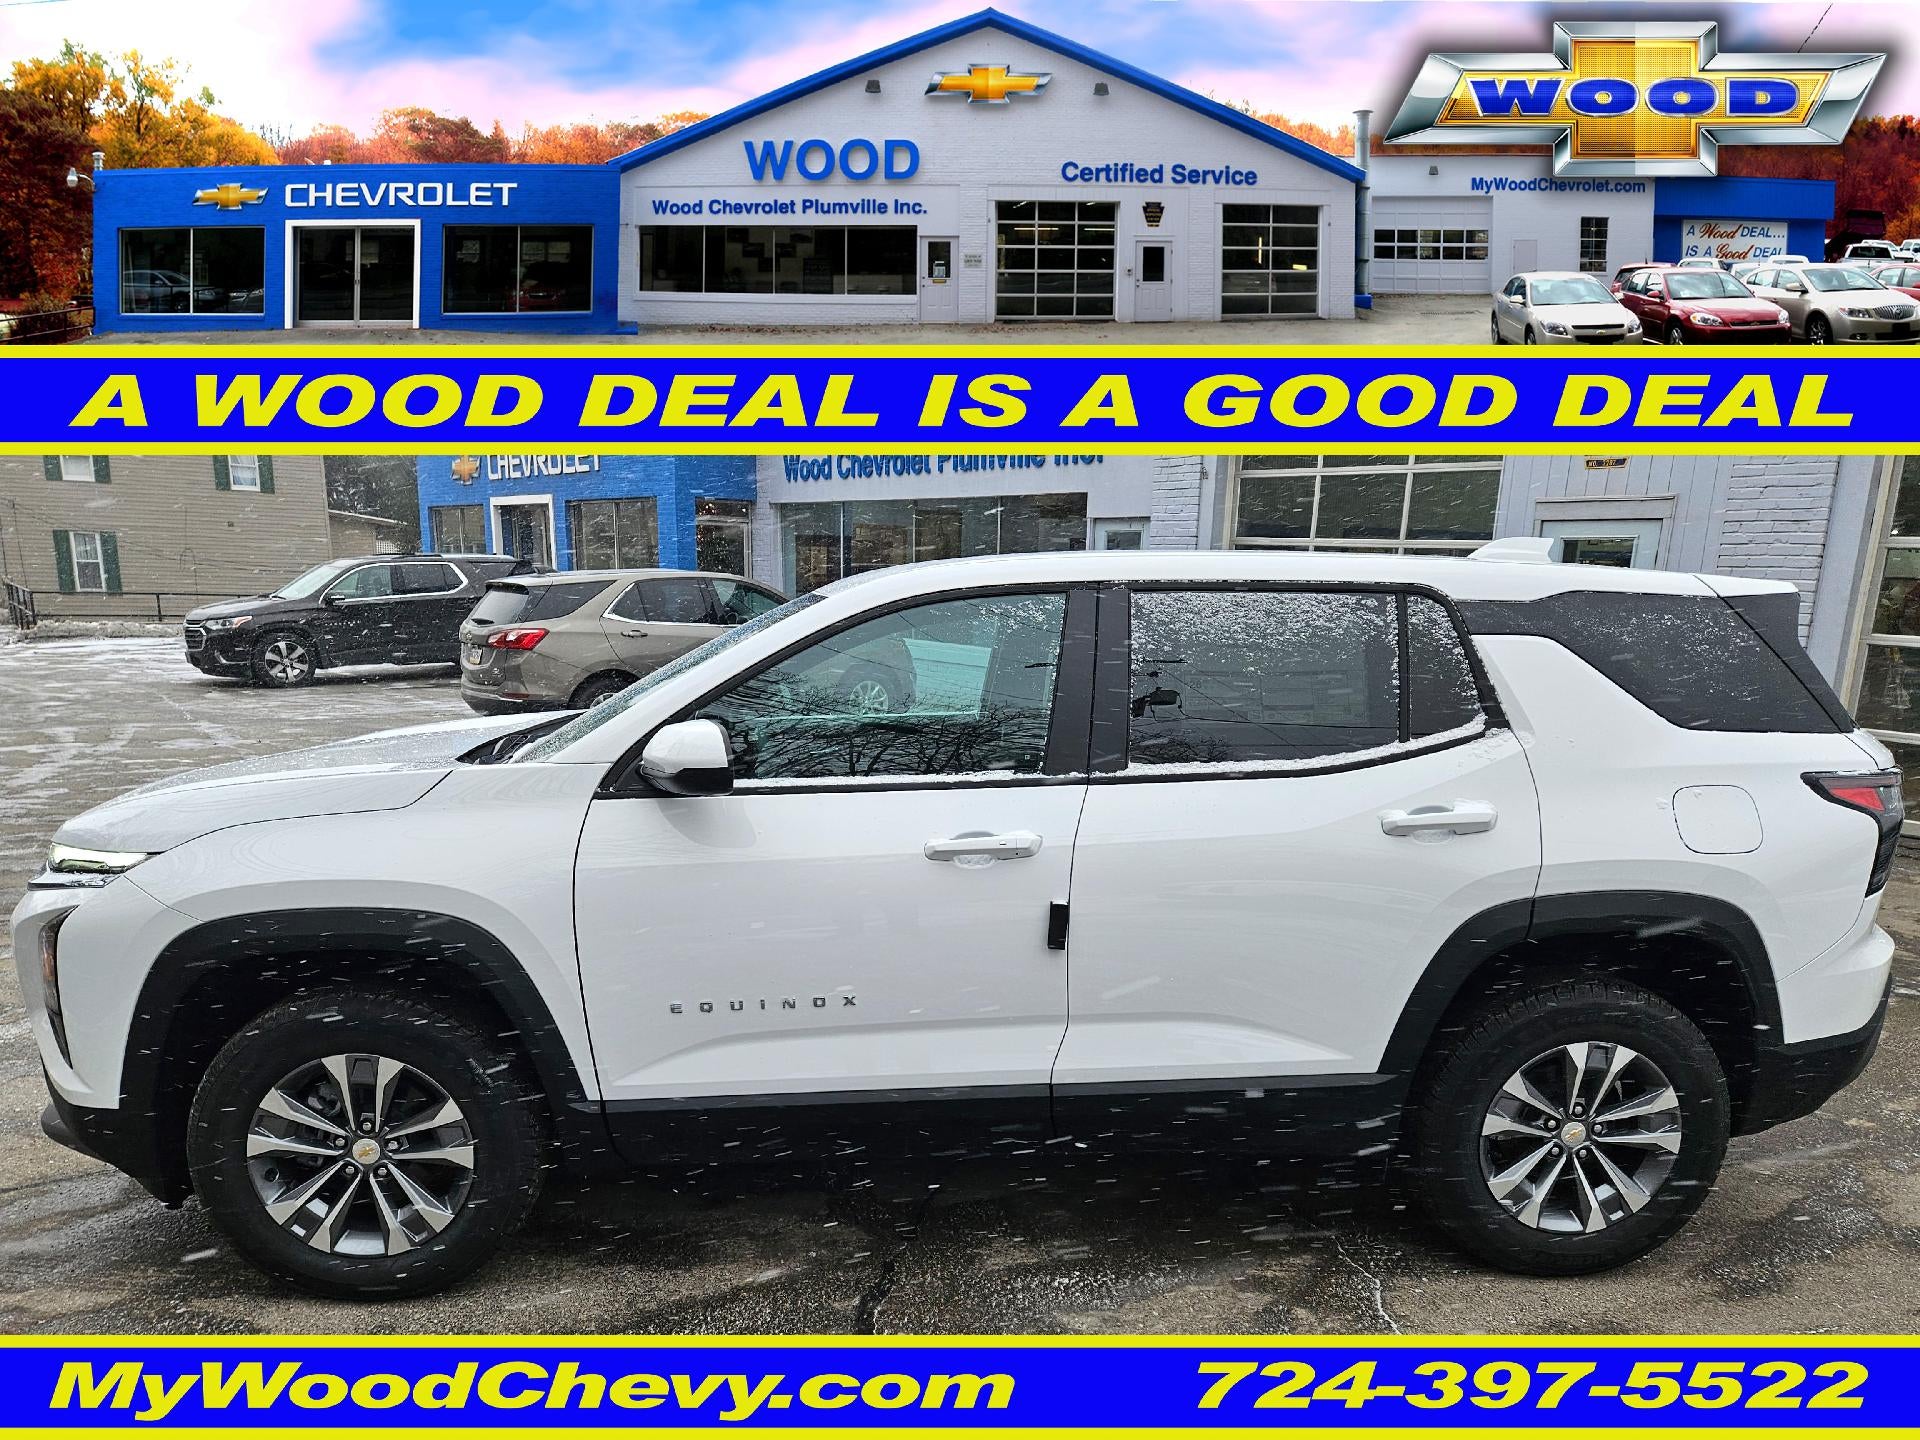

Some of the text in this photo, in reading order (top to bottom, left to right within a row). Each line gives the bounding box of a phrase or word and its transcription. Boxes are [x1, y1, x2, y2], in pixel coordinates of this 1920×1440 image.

[742, 136, 922, 183] WOOD
[1060, 160, 1259, 187] Certified Service
[284, 182, 518, 208] CHEVROLET
[1470, 176, 1647, 195] MyWoodChevrolet.com
[652, 197, 929, 216] Wood Chevrolet Plumville Inc.
[1686, 222, 1786, 240] A Wood DEAL...
[1685, 245, 1699, 257] IS
[1703, 246, 1713, 257] A
[1715, 243, 1756, 260] Good
[783, 455, 833, 483] Wood
[669, 995, 857, 1014] EQUINOX
